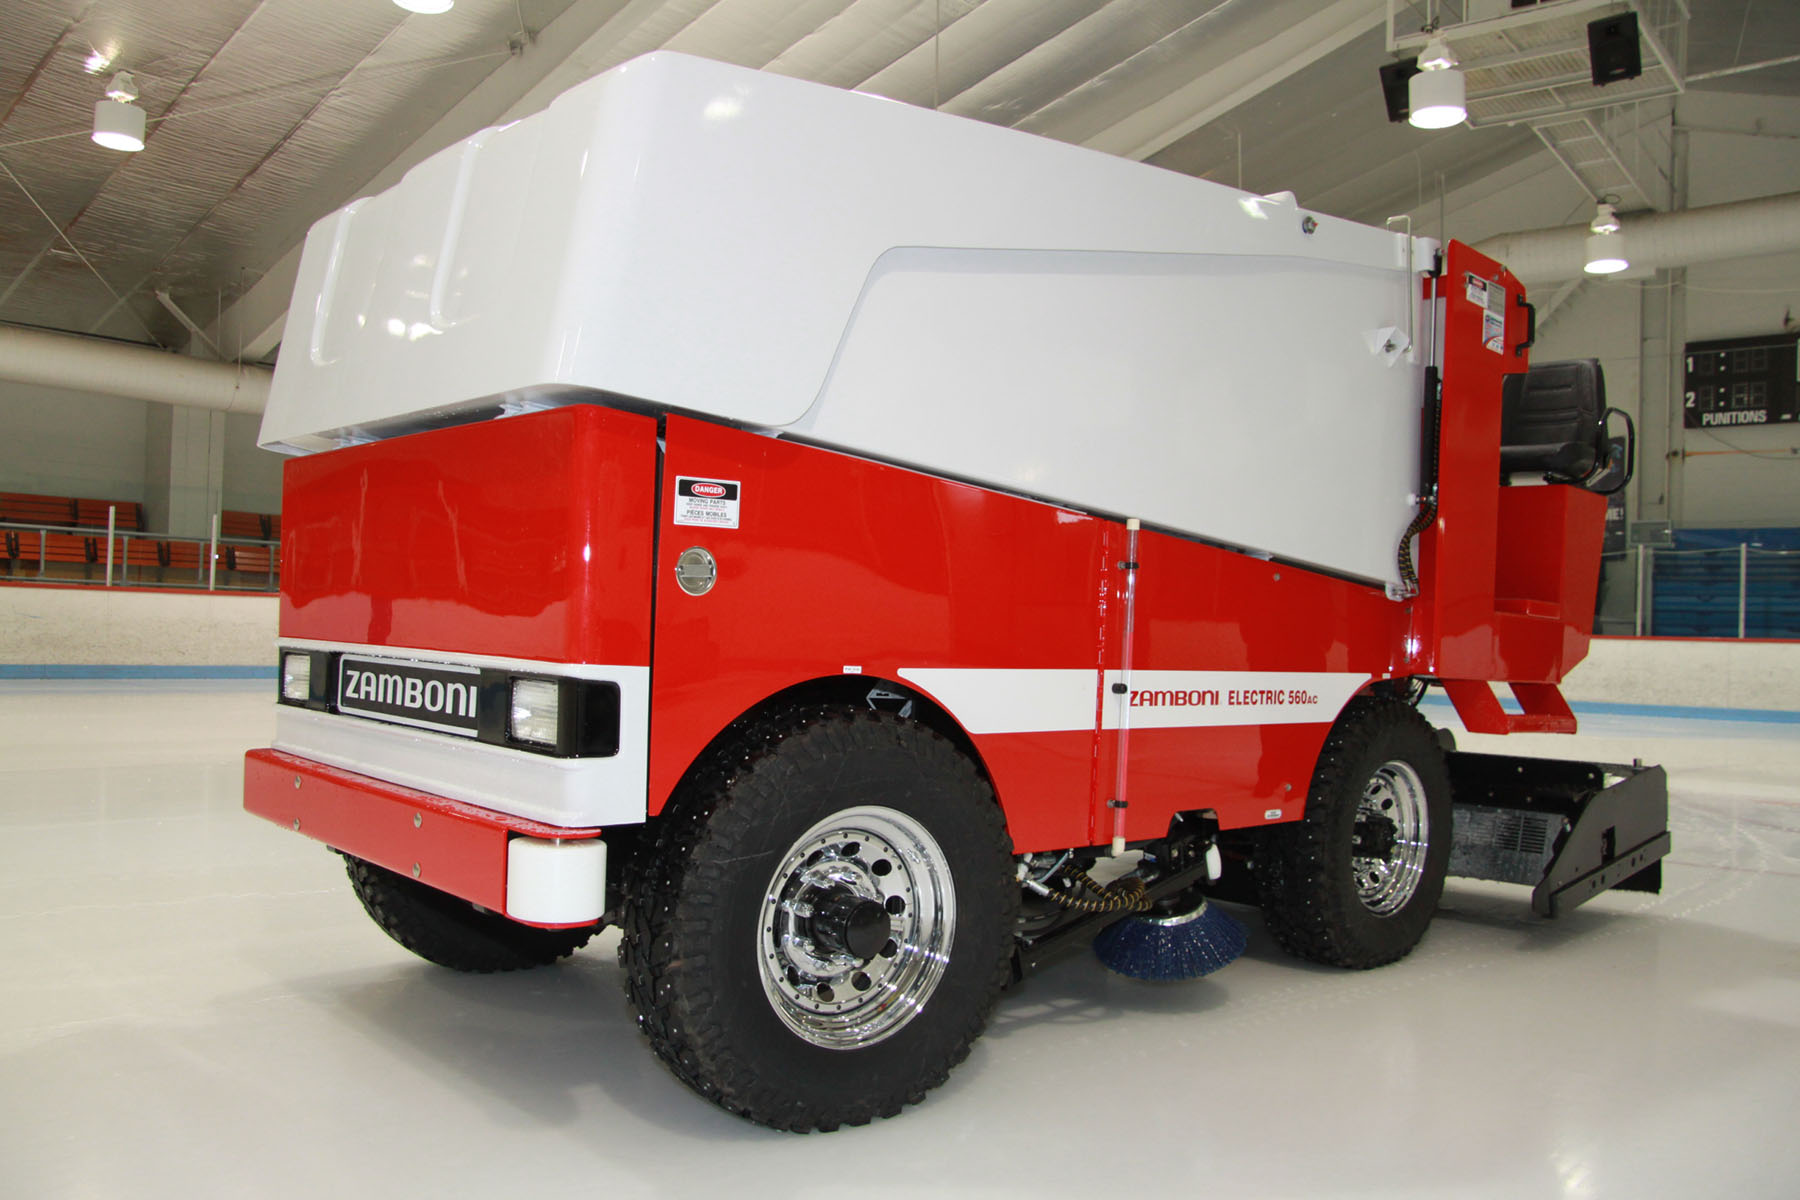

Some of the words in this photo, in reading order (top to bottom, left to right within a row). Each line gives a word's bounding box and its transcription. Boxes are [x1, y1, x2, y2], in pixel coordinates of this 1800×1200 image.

[1685, 392, 1695, 407] 2
[1702, 410, 1767, 425] PUNITIONS
[694, 485, 723, 494] DANGER
[345, 669, 478, 718] ZAMBONI
[1130, 690, 1219, 706] ZAMBONI
[1228, 690, 1285, 705] ELECTRIC
